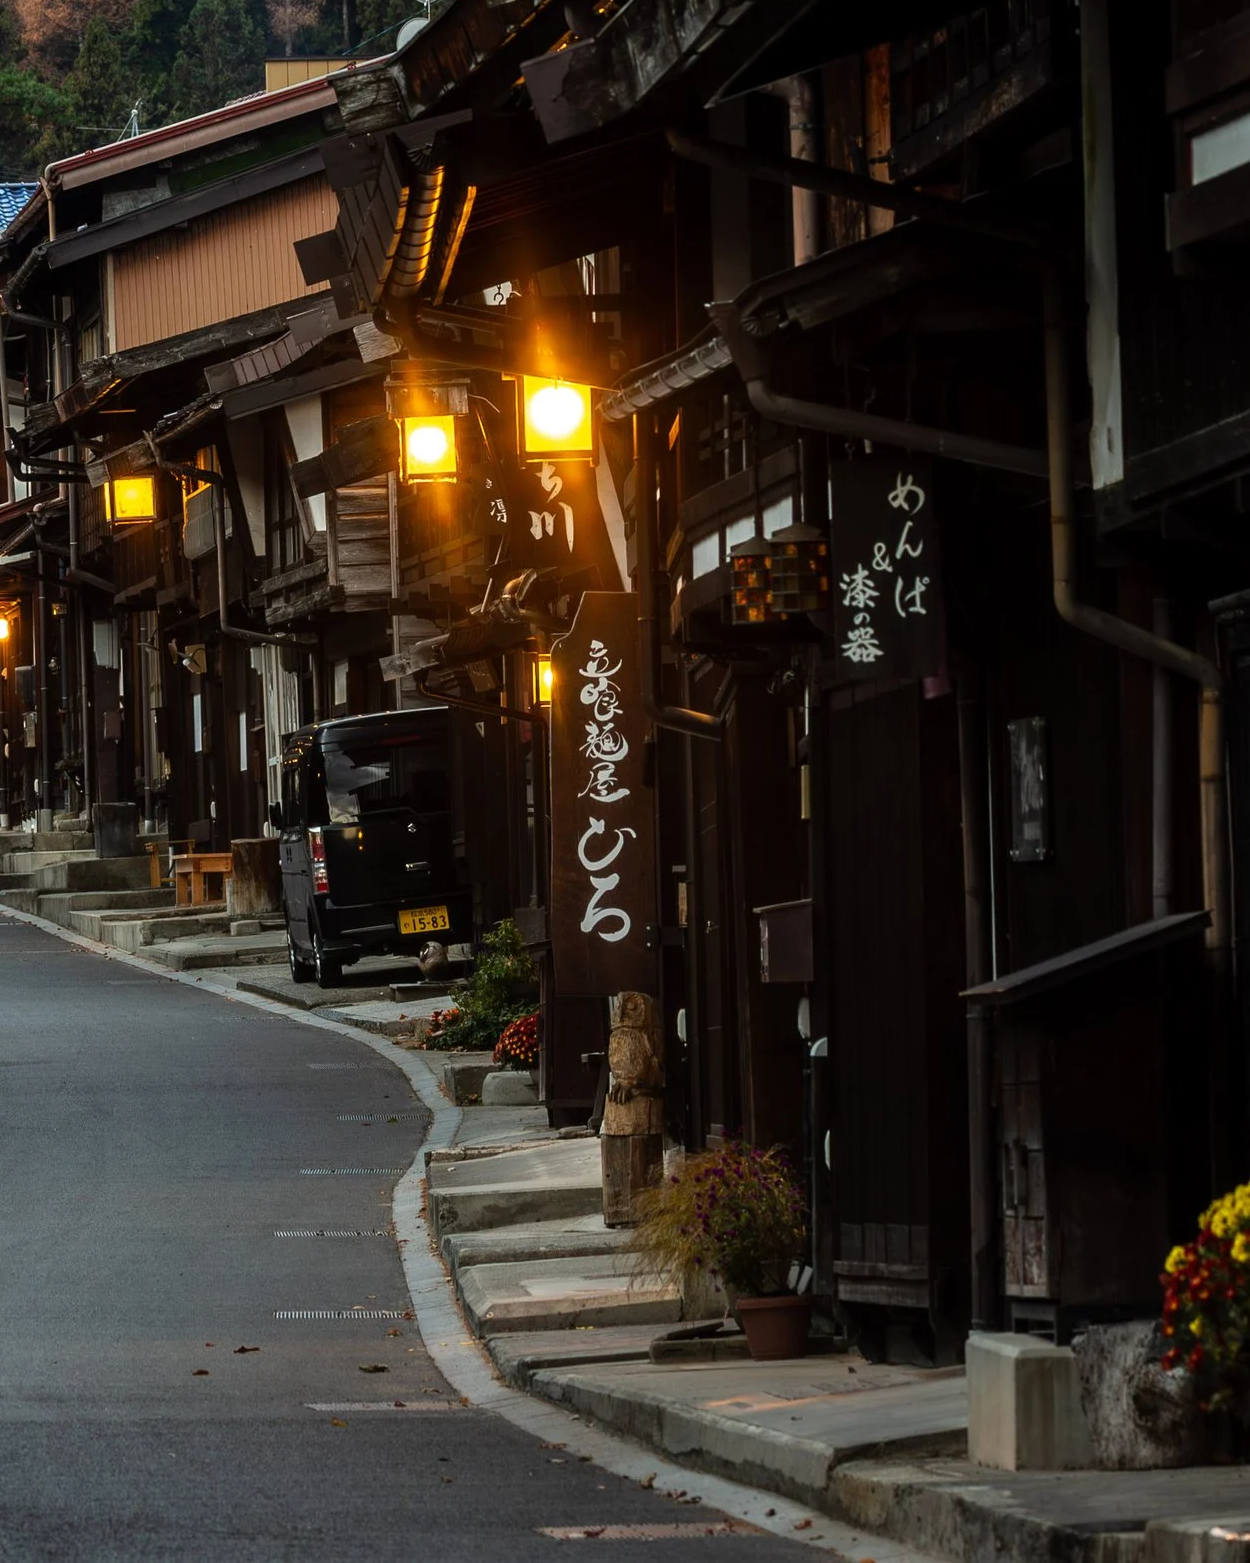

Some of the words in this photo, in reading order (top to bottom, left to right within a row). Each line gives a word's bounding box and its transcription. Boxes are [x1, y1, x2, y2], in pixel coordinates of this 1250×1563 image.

[871, 542, 894, 573] &
[887, 471, 931, 618] めんぱ
[839, 563, 885, 663] 漆の器
[412, 915, 447, 931] 15-83
[578, 816, 637, 942] ひろ
